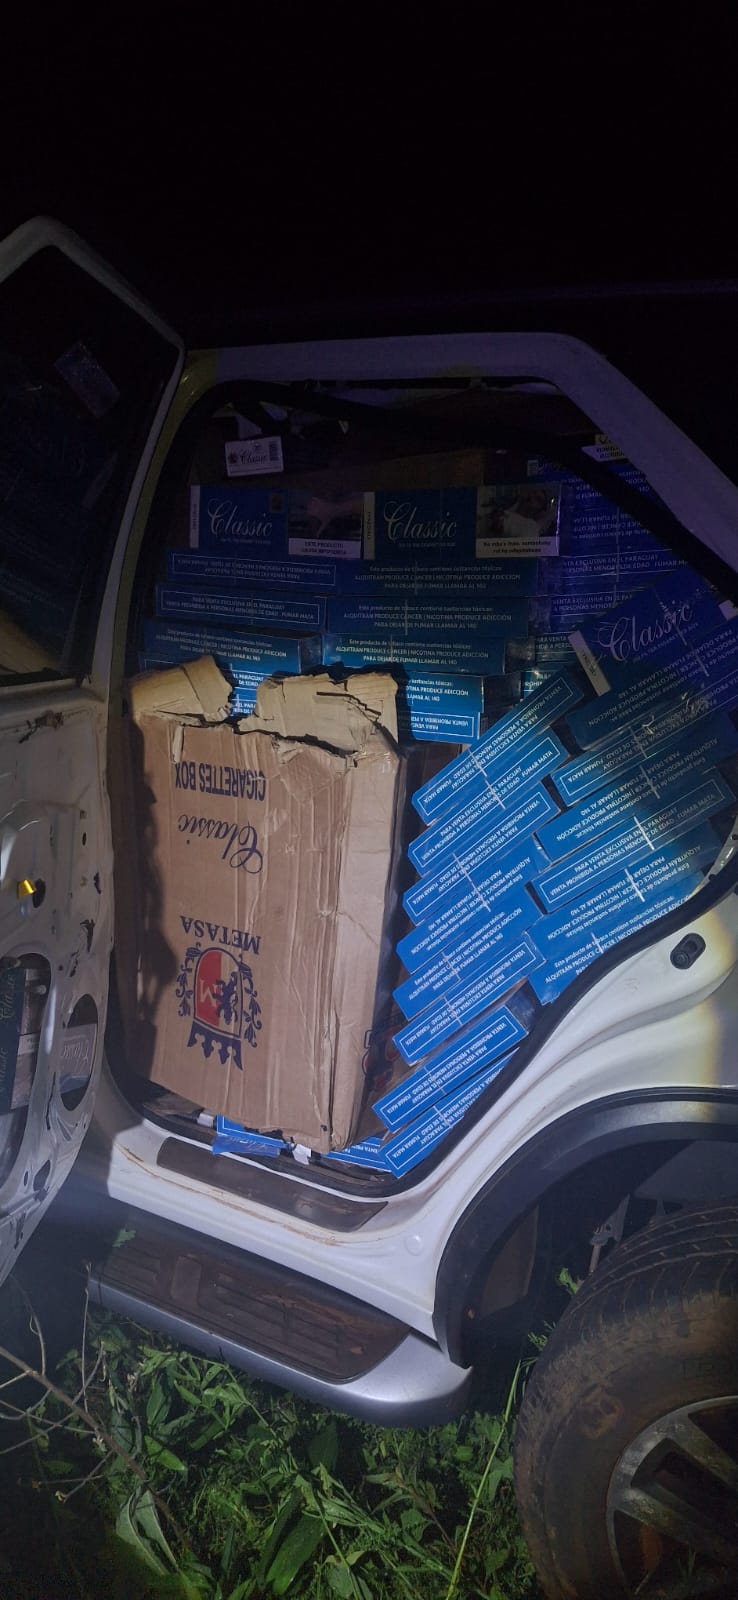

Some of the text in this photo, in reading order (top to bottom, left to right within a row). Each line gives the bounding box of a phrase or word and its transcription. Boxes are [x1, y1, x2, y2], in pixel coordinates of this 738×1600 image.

[208, 497, 272, 538] Classic
[383, 501, 457, 543] Classic
[596, 601, 693, 661] Classic
[175, 762, 266, 800] CIGARETTES BOX
[178, 814, 263, 874] Classic
[180, 916, 261, 955] METASA
